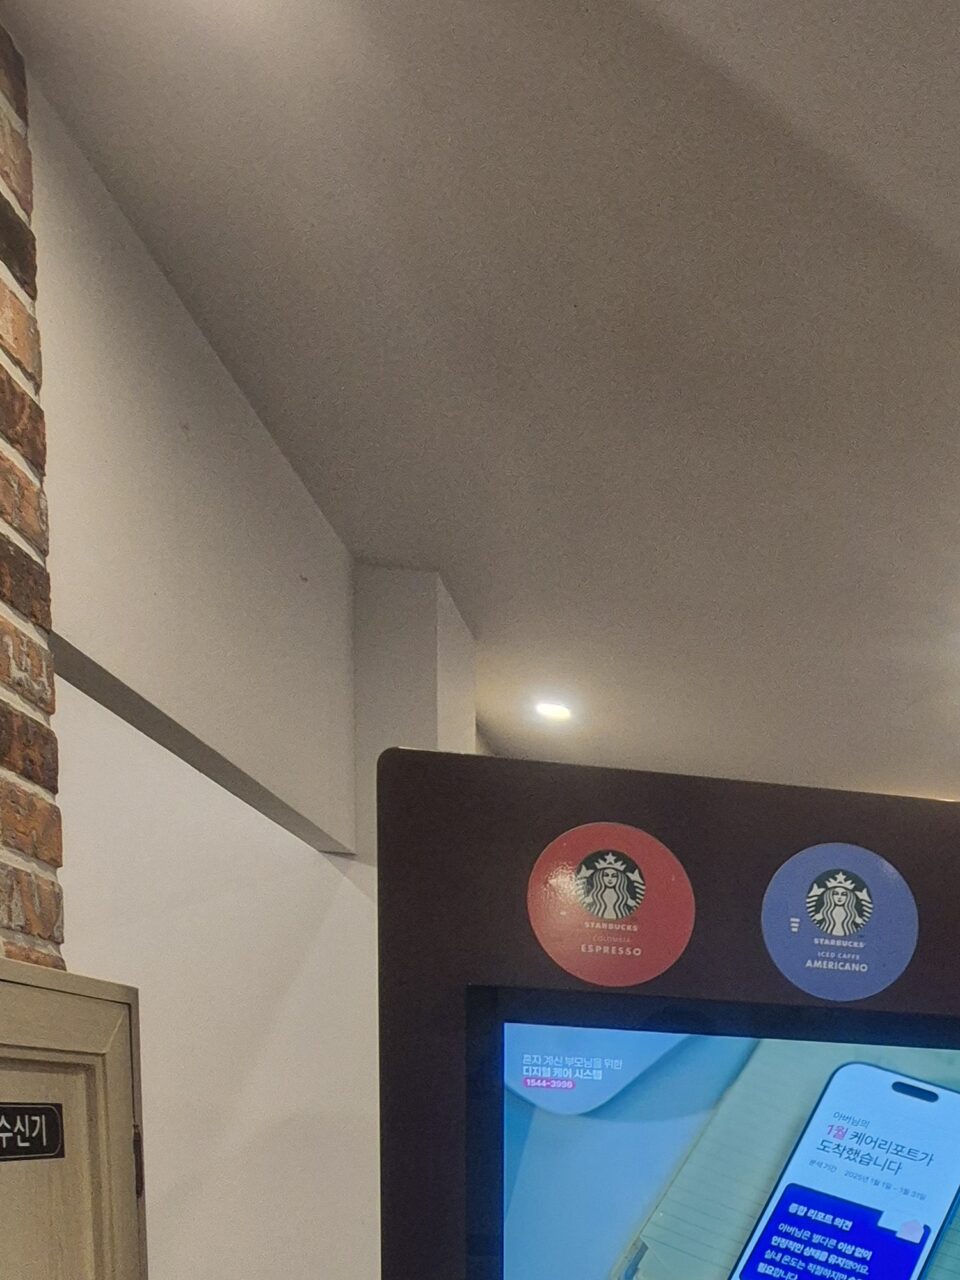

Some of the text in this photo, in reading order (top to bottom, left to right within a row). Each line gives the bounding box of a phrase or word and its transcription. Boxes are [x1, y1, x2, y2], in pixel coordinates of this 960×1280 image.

[583, 921, 638, 932] STARBUCKS
[580, 943, 642, 957] ESPRESSO
[813, 938, 865, 948] STARBUCKS
[805, 960, 868, 972] AMERICANO
[564, 1057, 602, 1070] 부모님을
[522, 1065, 603, 1081] 디지털 케어 시스템
[833, 1111, 871, 1129] 아버님의
[827, 1124, 935, 1167] 1월 케어리포트가
[816, 1139, 902, 1177] 도착했습니다
[807, 1208, 834, 1225] 리포트
[778, 1222, 811, 1241] 아버님은
